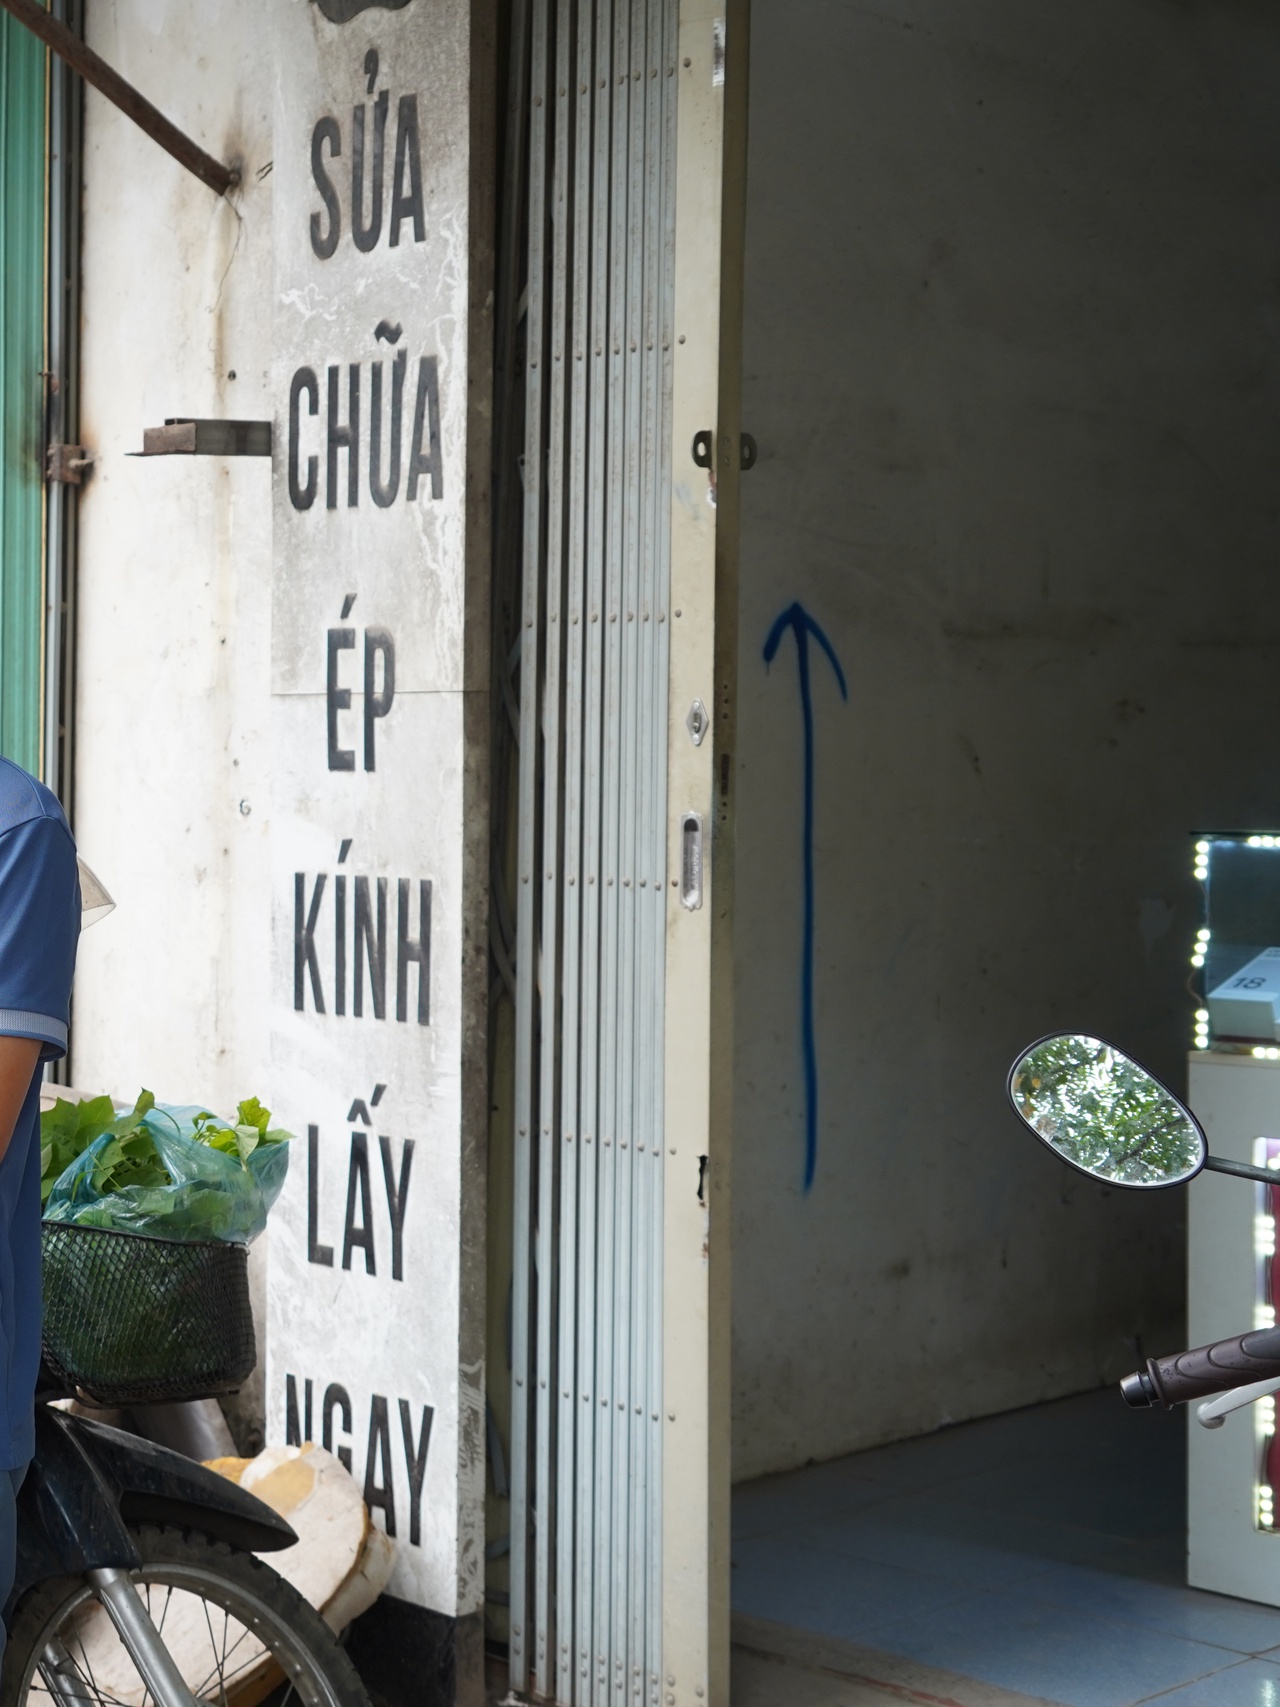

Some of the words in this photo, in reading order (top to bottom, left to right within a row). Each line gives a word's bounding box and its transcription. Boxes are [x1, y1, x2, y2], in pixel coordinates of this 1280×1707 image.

[310, 48, 426, 260] SỬA
[288, 319, 444, 511] CHỮA
[327, 593, 396, 772] ÉP
[295, 839, 432, 1026] KÍNH
[308, 1084, 415, 1281] LẤY
